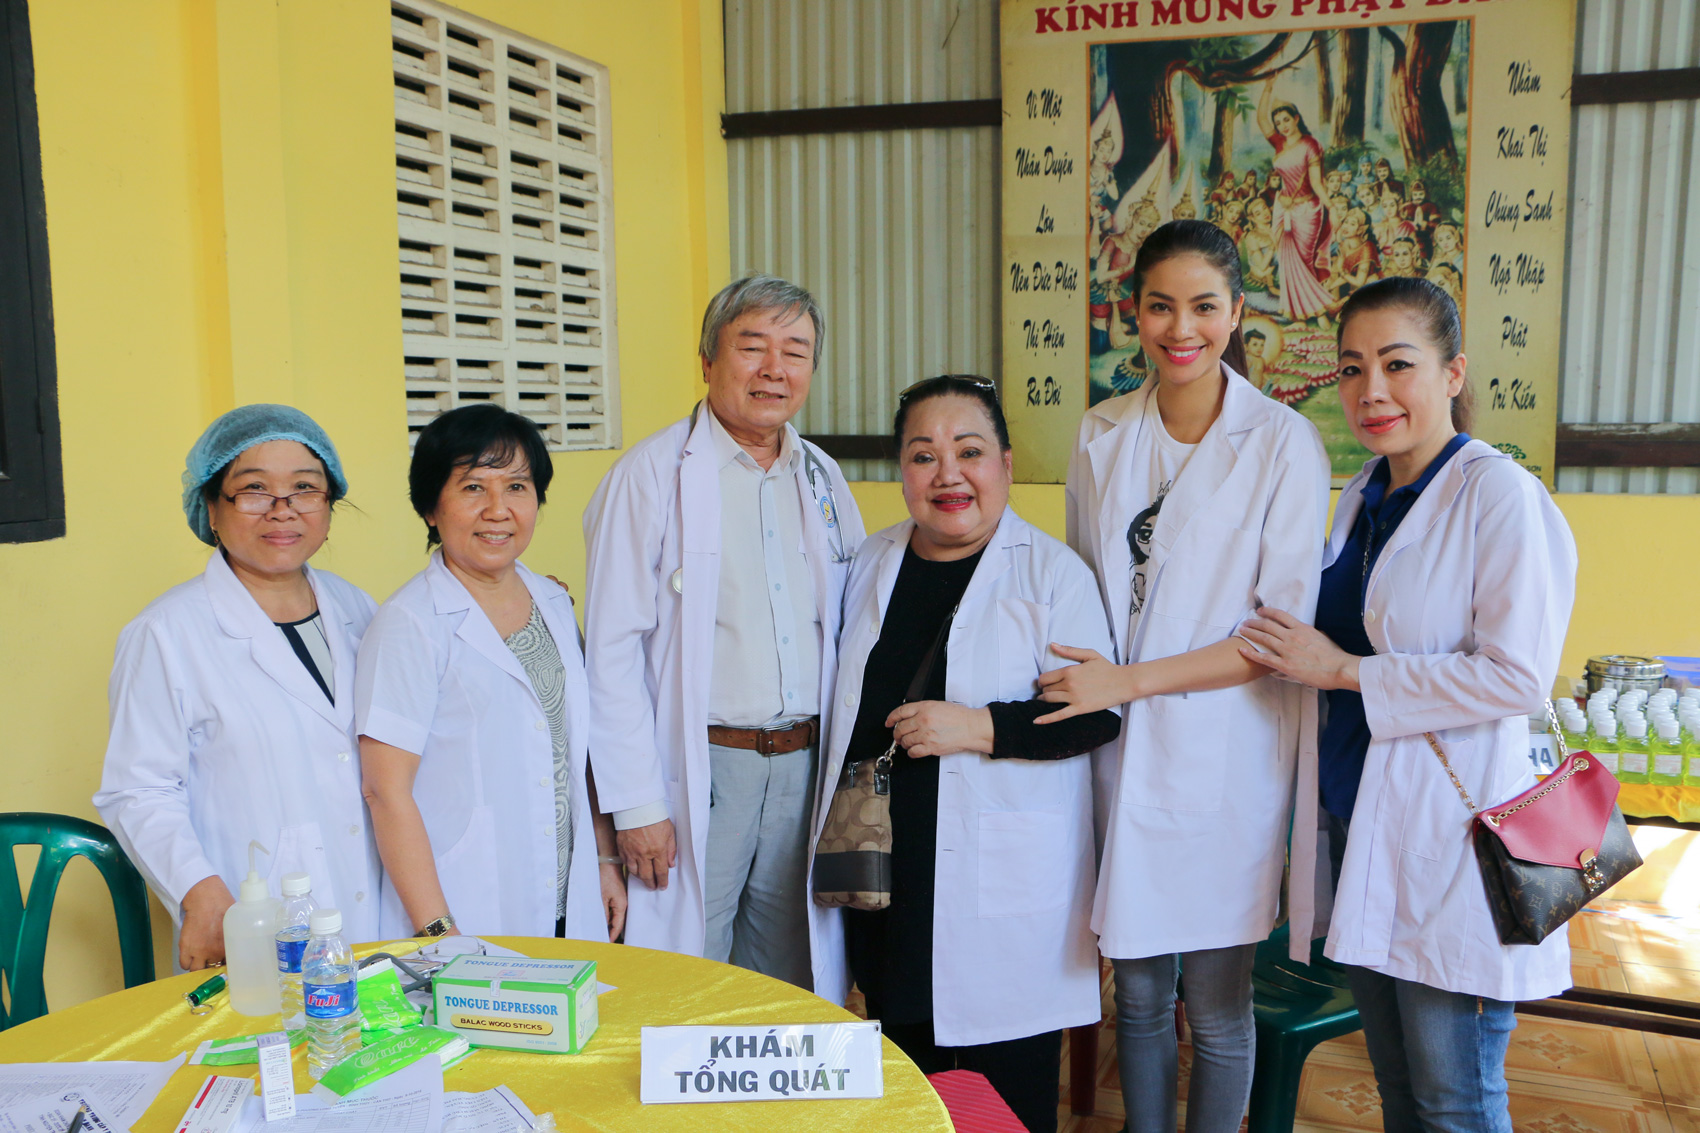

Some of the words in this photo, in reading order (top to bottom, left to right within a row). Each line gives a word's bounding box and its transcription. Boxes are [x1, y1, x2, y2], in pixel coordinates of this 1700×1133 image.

[1041, 88, 1062, 126] Một
[1497, 126, 1525, 159] Khai
[1529, 124, 1548, 166] Thị
[1015, 147, 1040, 178] Nhân
[1044, 146, 1073, 182] Duyên
[1485, 190, 1520, 232] Chúng
[1524, 189, 1554, 222] Sanh
[1011, 262, 1029, 293] Nên
[1033, 261, 1051, 292] Đức
[1054, 261, 1078, 299] Phật
[1489, 253, 1512, 296] Ngộ
[1516, 252, 1545, 294] Nhập
[1024, 319, 1040, 357] Thị
[1042, 319, 1065, 357] Hiện
[1502, 315, 1528, 356] Phật
[1027, 377, 1041, 407] Ra
[1490, 378, 1507, 410] Tri
[1510, 378, 1536, 410] Kiến
[444, 996, 490, 1010] TONGUE
[492, 1000, 558, 1016] DEPRESSOR
[460, 1018, 486, 1026] BALAC
[488, 1020, 511, 1028] WOOD
[514, 1022, 542, 1030] STICKS
[710, 1029, 814, 1058] KHÁM
[674, 1059, 759, 1093] TỔNG
[769, 1063, 850, 1096] QUÁT
